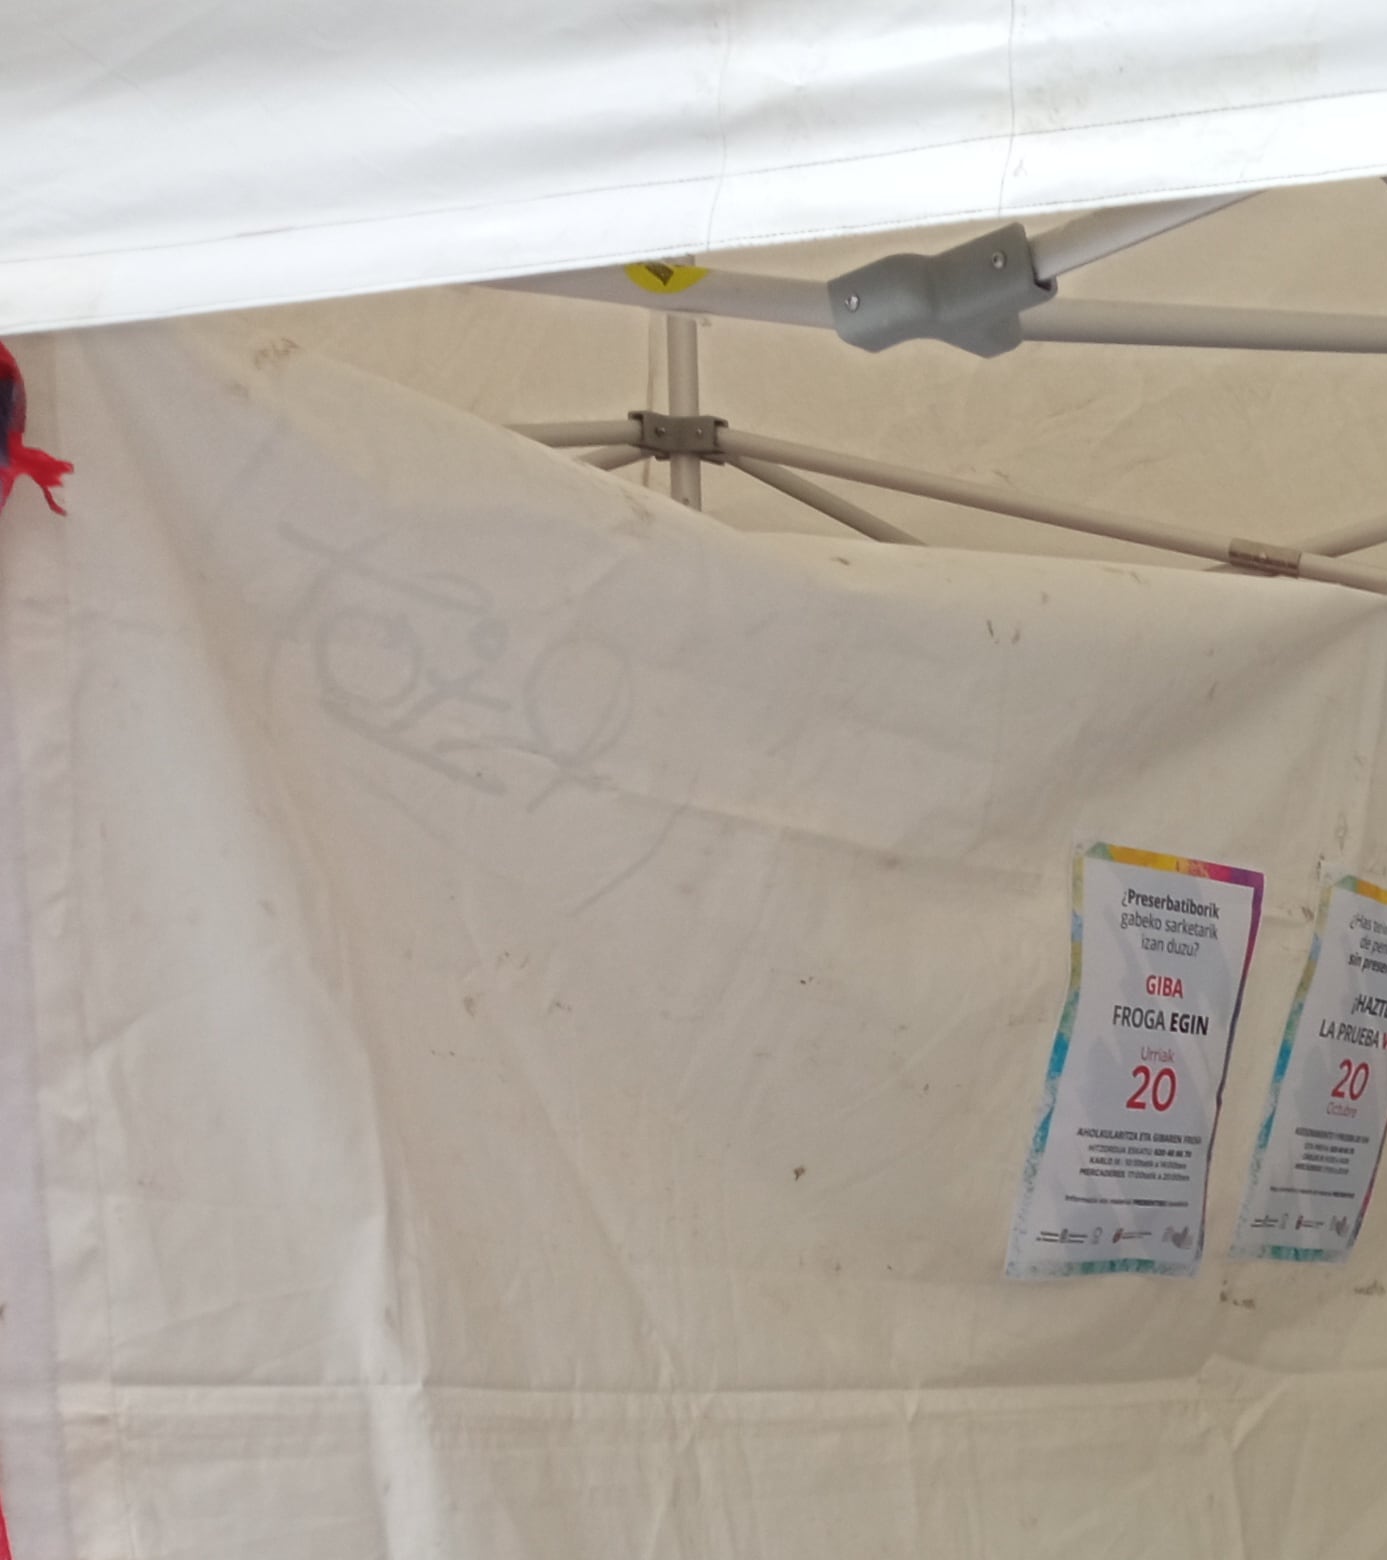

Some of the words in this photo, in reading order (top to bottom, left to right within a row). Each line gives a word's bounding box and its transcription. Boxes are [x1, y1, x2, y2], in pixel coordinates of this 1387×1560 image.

[1122, 889, 1220, 919] ¿Preserbatiborik
[1120, 912, 1162, 930] gabeko
[1165, 919, 1218, 940] sarketarik
[1141, 934, 1164, 952] izan
[1167, 938, 1200, 957] duzu?
[1146, 974, 1184, 999] GIBA
[1112, 1004, 1166, 1031] FROGA
[1169, 1012, 1209, 1036] EGIN
[1319, 1019, 1335, 1039] LA
[1337, 1021, 1379, 1049] PRUEBA
[1125, 1064, 1177, 1112] 20
[1331, 1058, 1369, 1101] 20
